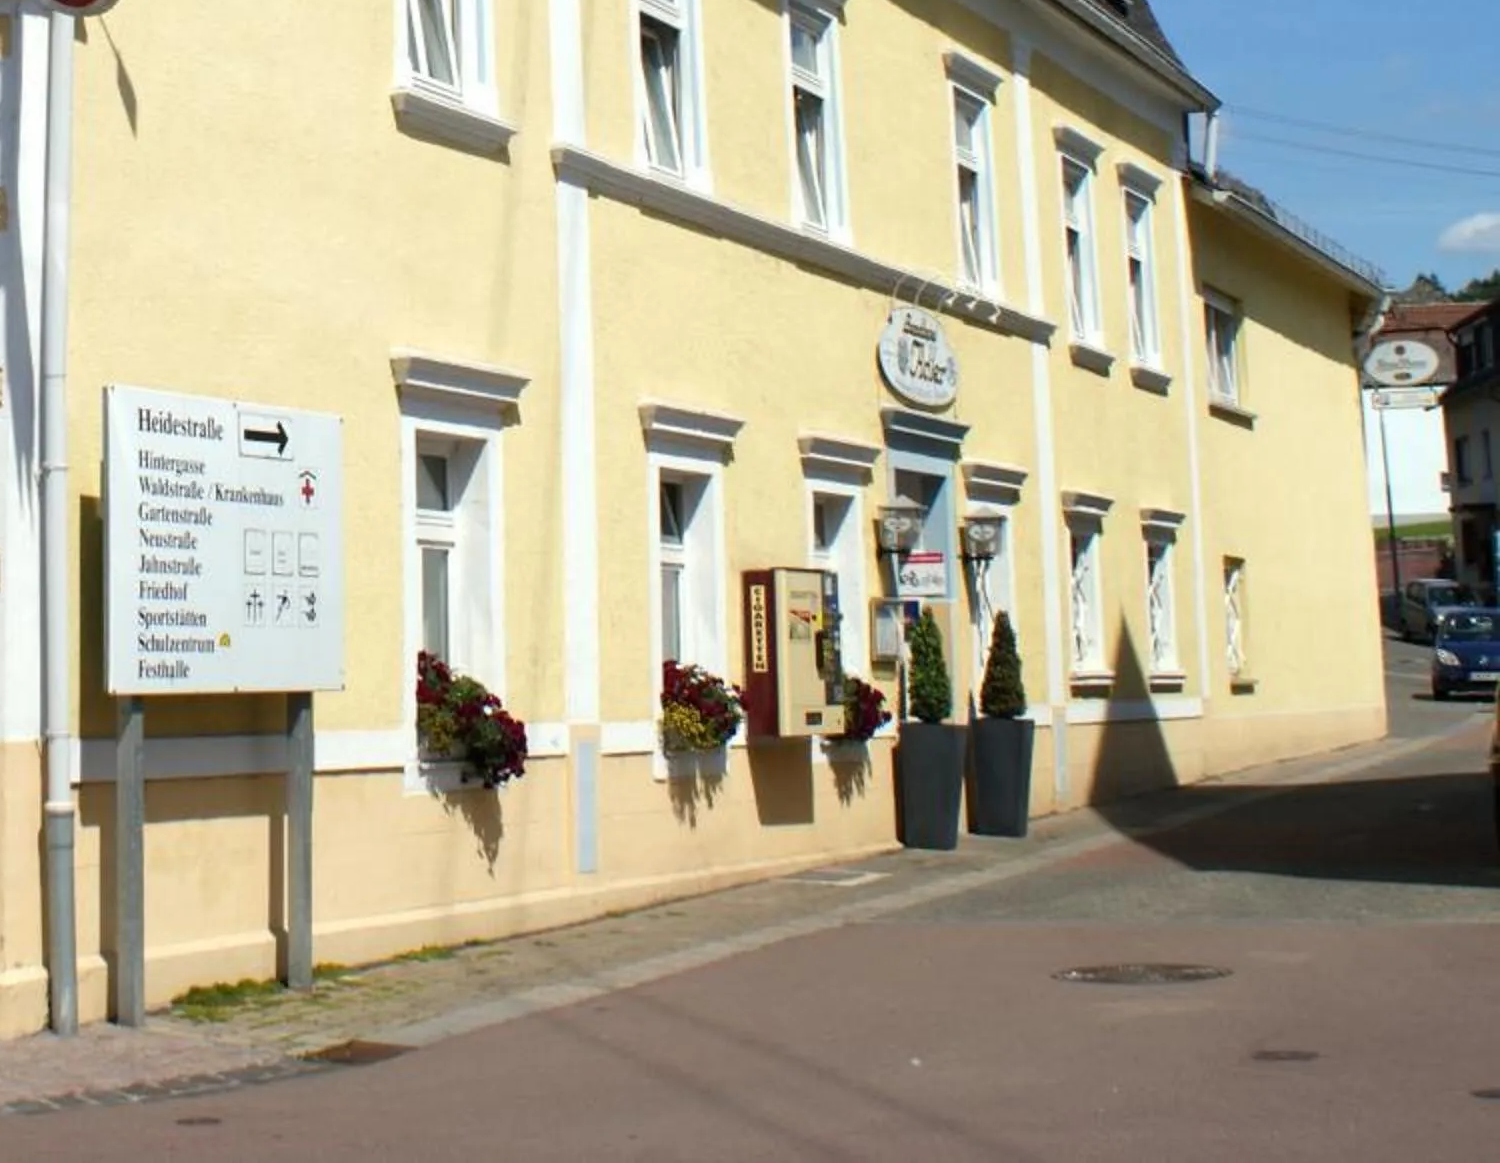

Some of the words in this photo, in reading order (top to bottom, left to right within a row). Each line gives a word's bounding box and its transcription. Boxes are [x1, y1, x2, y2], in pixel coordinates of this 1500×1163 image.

[138, 407, 224, 441] Heidestraße
[138, 449, 206, 477] Hintergasse
[139, 474, 205, 500] Waldstraße
[215, 482, 284, 507] Krankenhaus
[138, 501, 213, 526] Gartenstraße
[139, 527, 198, 550] Neustraße
[138, 553, 202, 577] Jahnstraße
[139, 580, 189, 601] Friedhof
[137, 605, 207, 630] Sportstätten
[752, 586, 766, 671] CIGARETTEN
[137, 632, 216, 654] Schulzentrum
[137, 658, 191, 680] Festhalle
